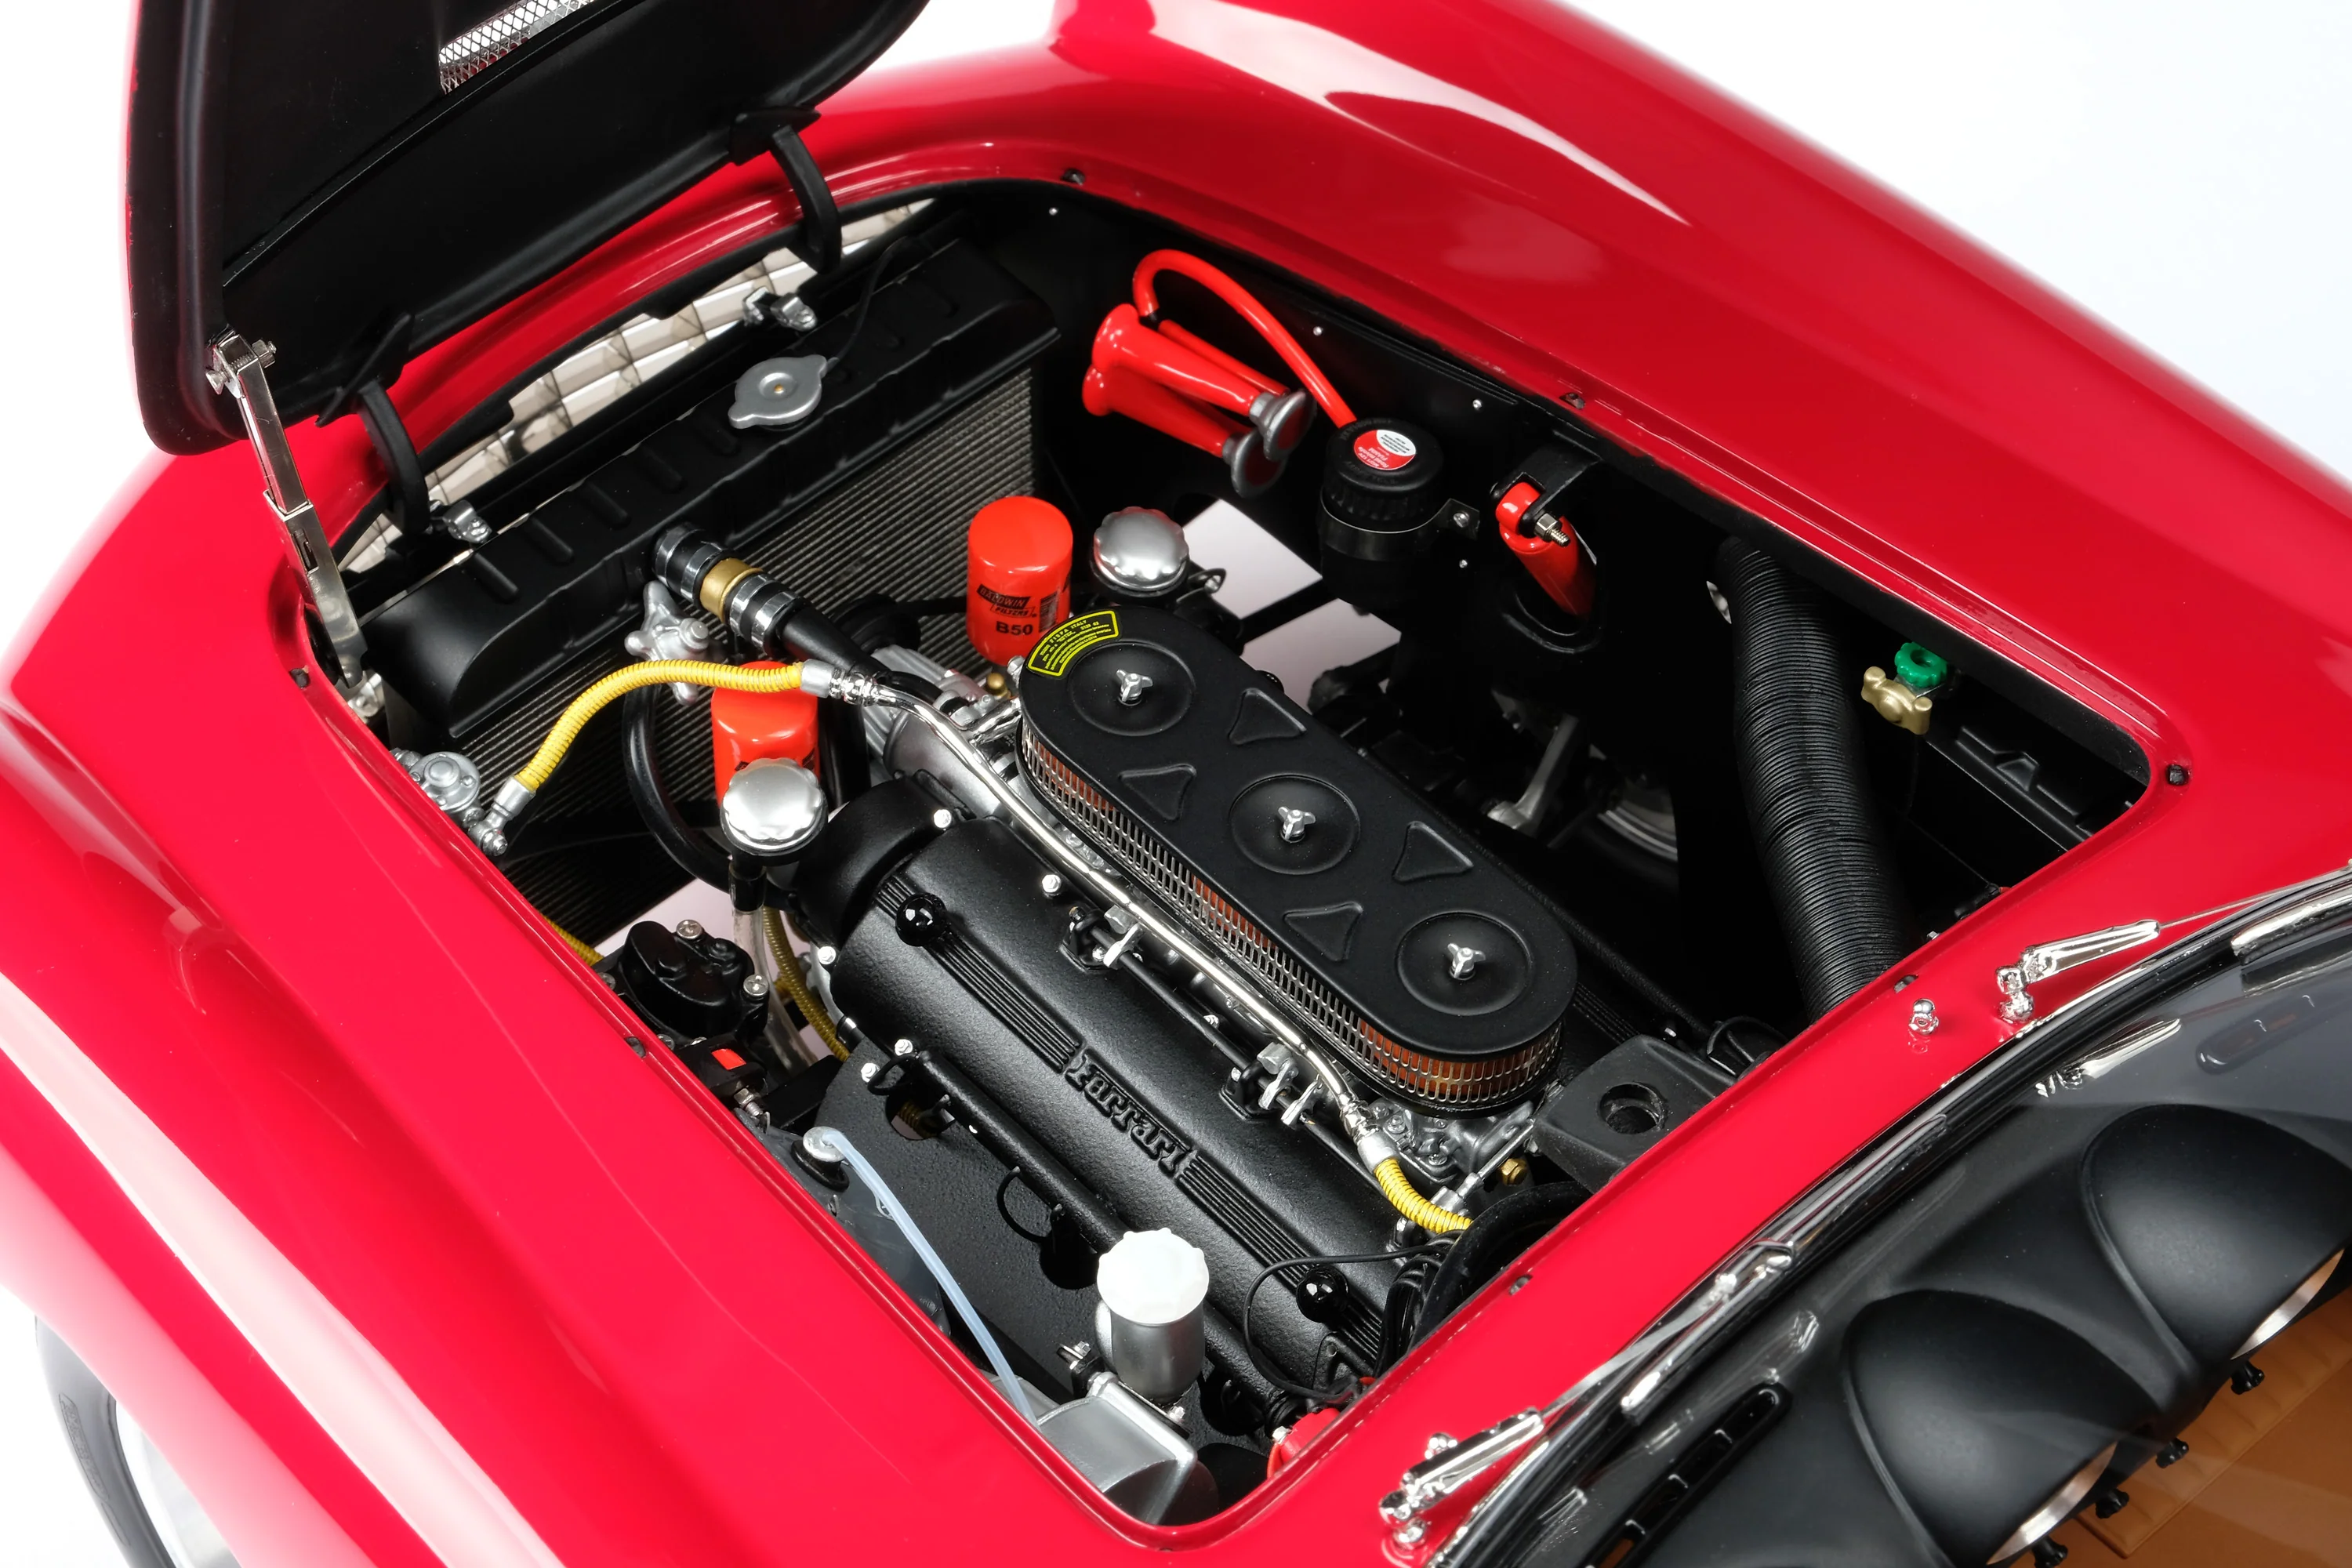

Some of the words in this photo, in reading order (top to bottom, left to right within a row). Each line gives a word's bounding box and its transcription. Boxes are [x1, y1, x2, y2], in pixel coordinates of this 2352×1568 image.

[980, 587, 1025, 608] BALDWIN
[995, 606, 1029, 616] FILTERS
[996, 620, 1033, 636] B50
[1070, 619, 1087, 630] ITALY
[1065, 1051, 1197, 1178] Ferrari
